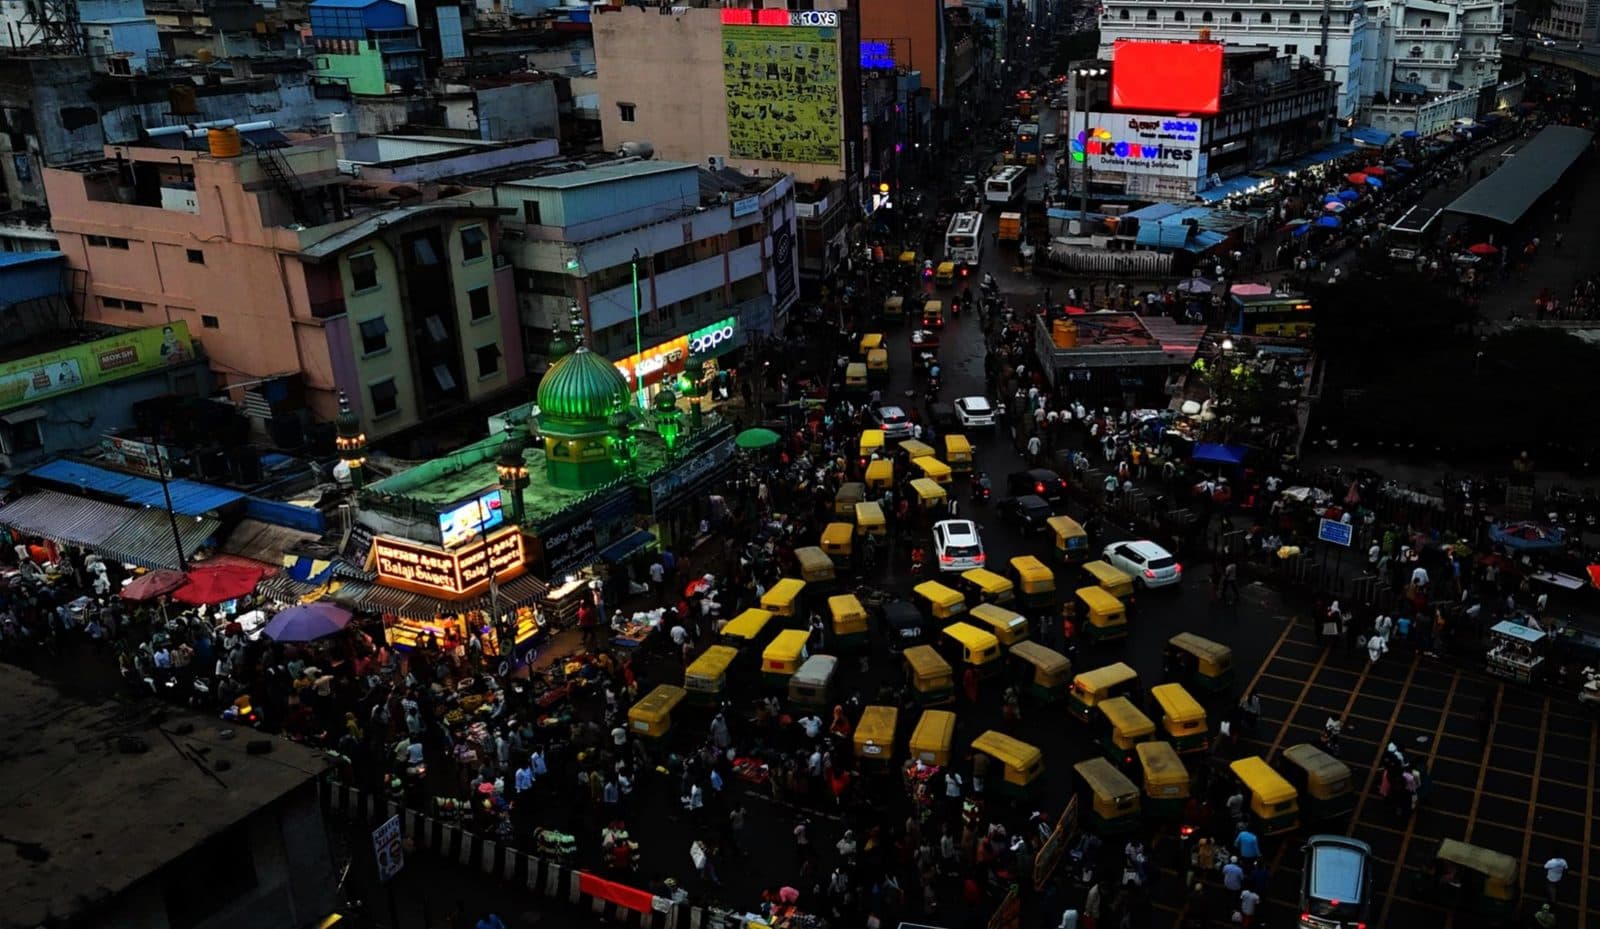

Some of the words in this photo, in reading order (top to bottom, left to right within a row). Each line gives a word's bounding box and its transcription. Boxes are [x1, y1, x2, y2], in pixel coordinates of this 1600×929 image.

[803, 13, 836, 25] TOYS
[1101, 156, 1125, 165] Durable
[1126, 159, 1150, 168] Fencing
[1151, 161, 1179, 169] Solutions
[692, 326, 733, 352] oppo
[490, 549, 520, 569] Sweets
[381, 558, 415, 579] Balaji
[416, 565, 455, 586] Sweets
